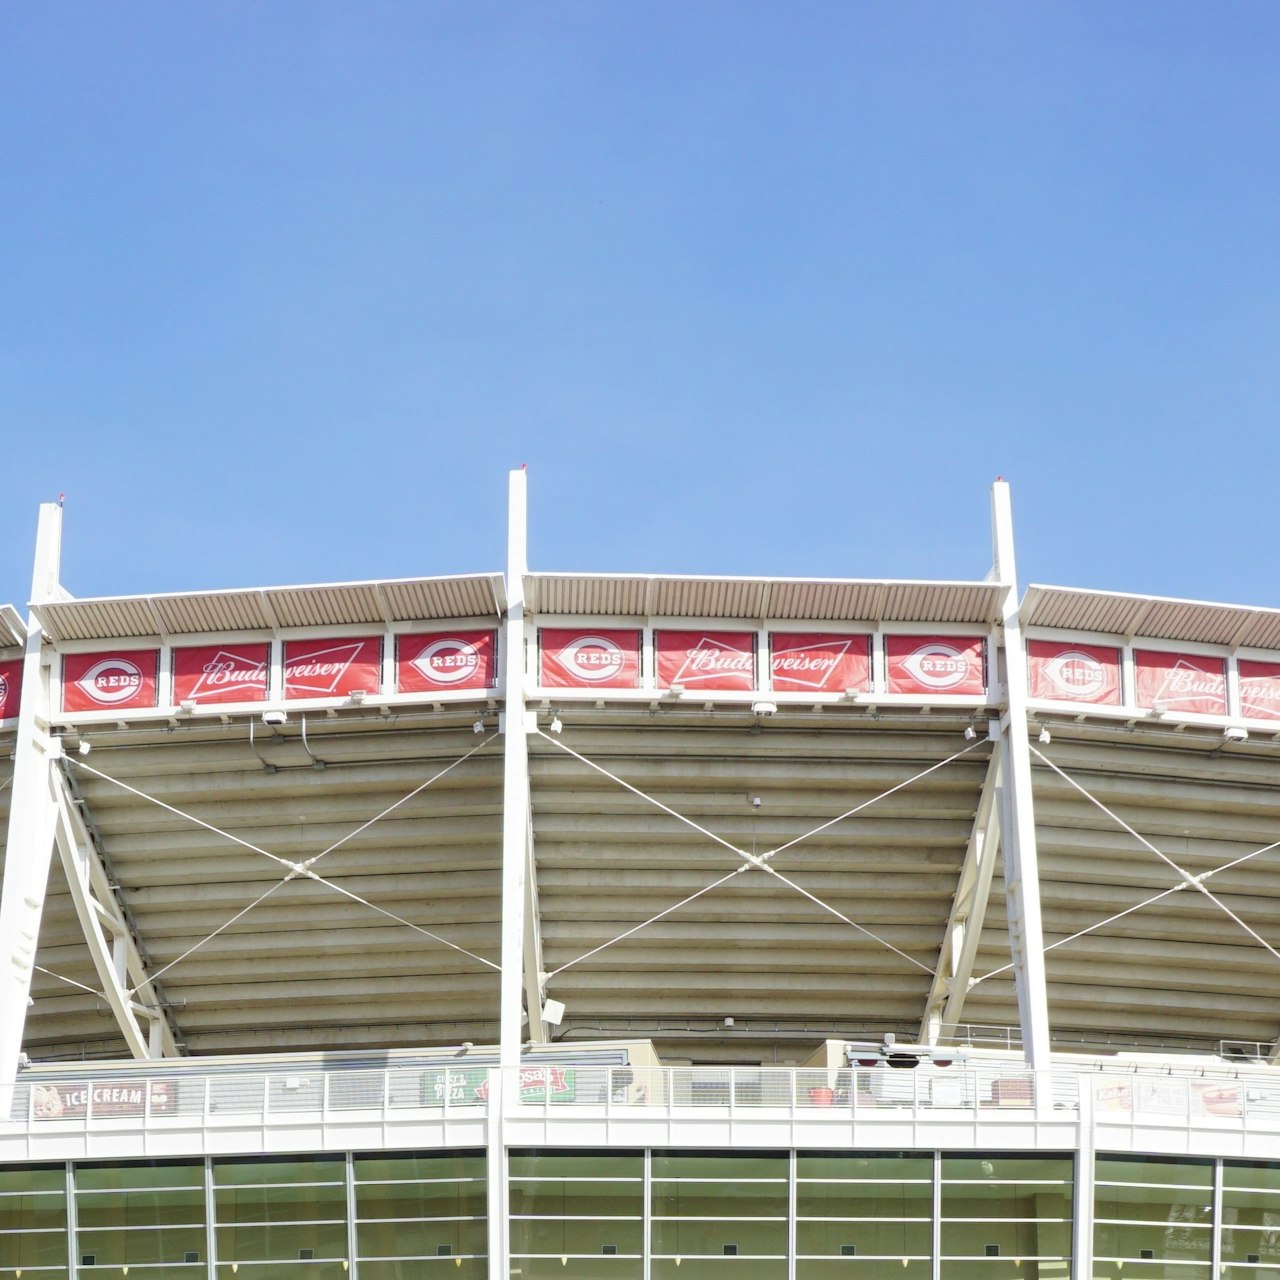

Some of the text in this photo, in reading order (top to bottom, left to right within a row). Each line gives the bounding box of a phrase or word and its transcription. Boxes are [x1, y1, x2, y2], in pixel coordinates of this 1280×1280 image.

[431, 654, 478, 668] REDS
[577, 651, 622, 666] REDS
[921, 659, 966, 674] REDS
[96, 673, 140, 688] REDS
[1062, 667, 1104, 683] REDS
[65, 1088, 143, 1107] ICE CREAM
